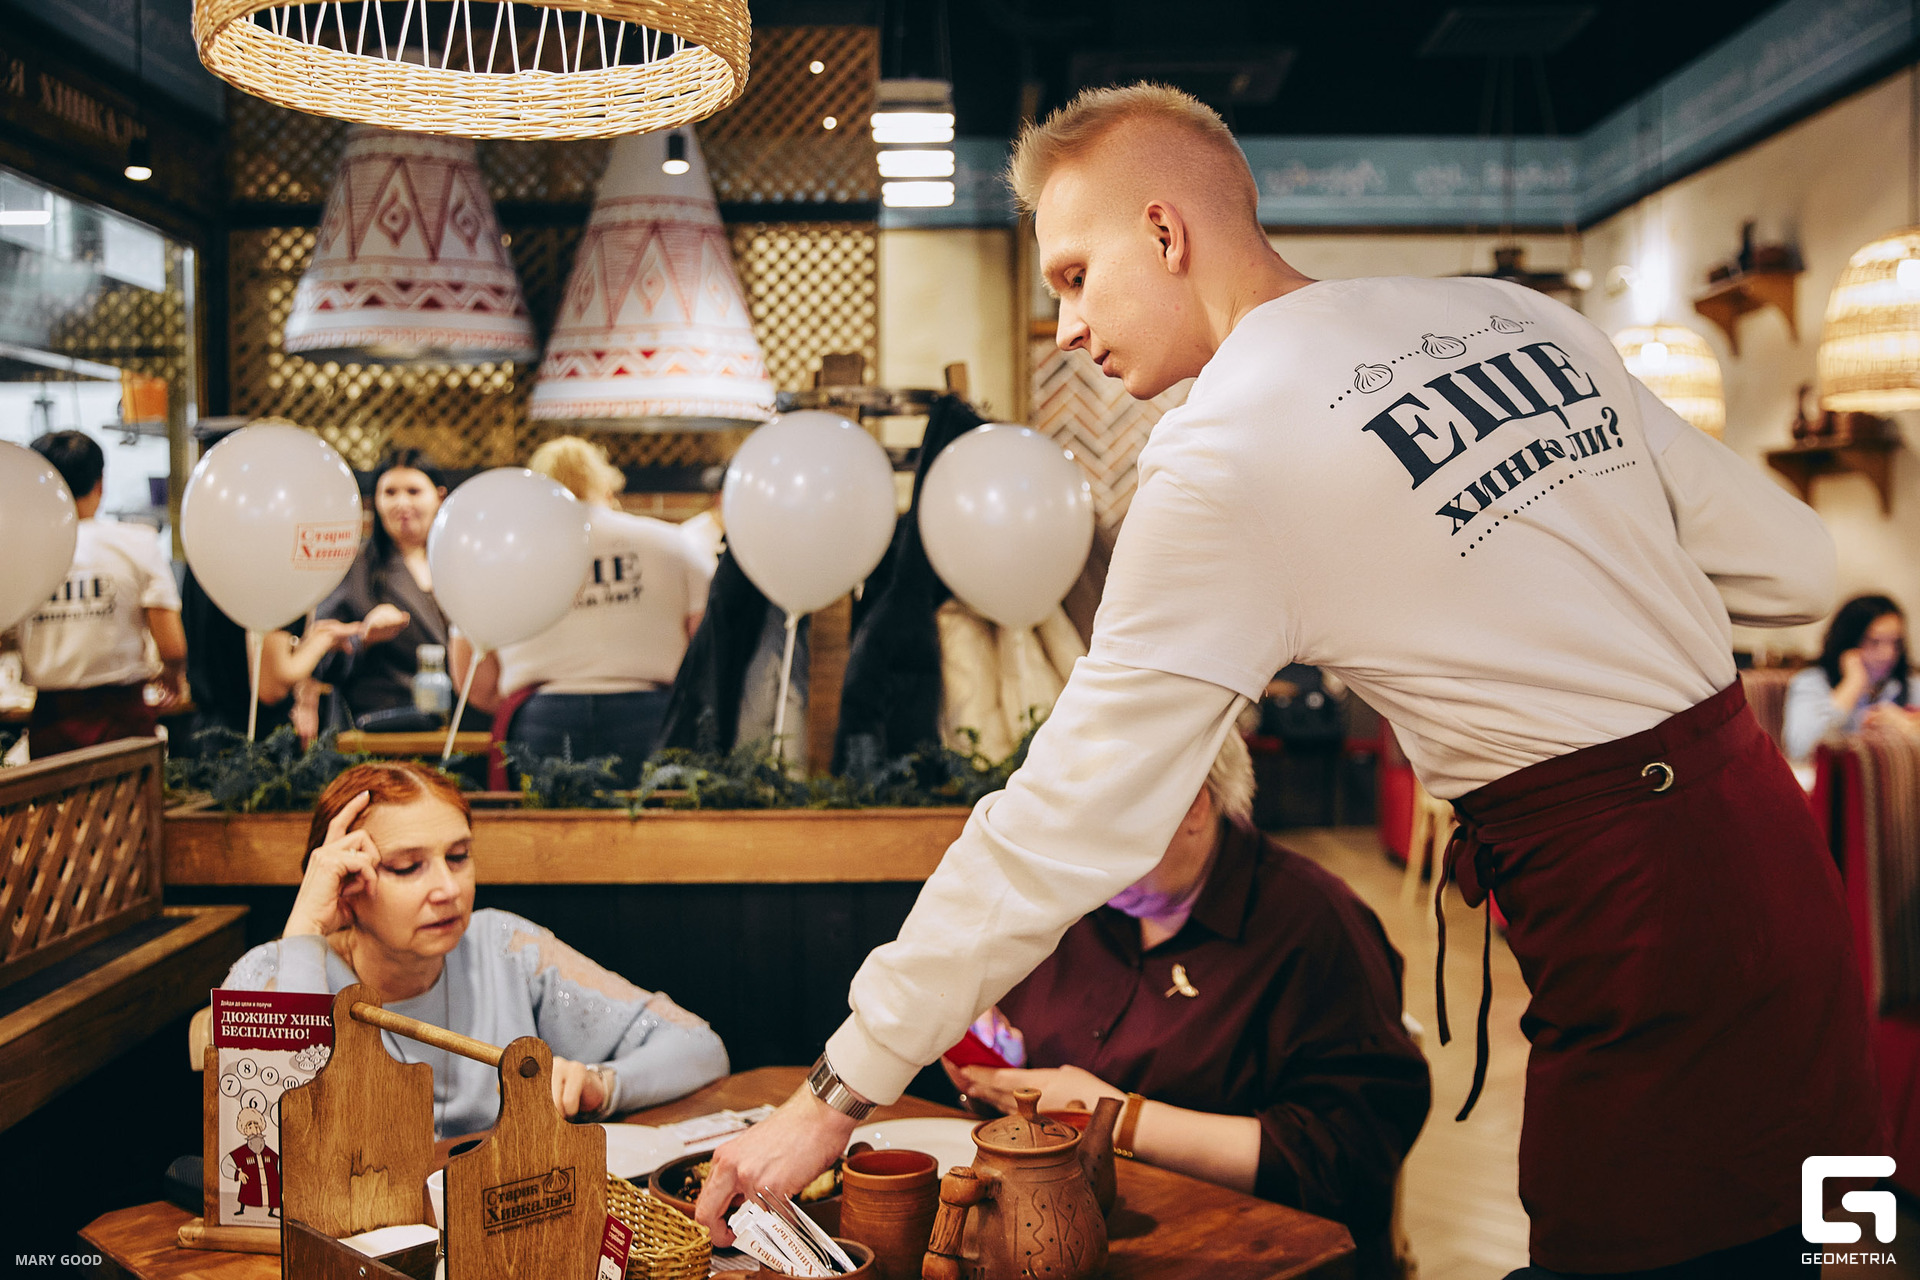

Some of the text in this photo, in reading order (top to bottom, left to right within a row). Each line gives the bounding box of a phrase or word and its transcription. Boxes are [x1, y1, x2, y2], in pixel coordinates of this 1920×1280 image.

[1361, 341, 1601, 490] ЕЩЕ
[221, 1011, 332, 1027] ДЮЖИНУ ХИНК
[222, 1026, 310, 1039] БЕСПЛАТНО!
[243, 1064, 251, 1074] 8
[267, 1071, 274, 1080] 9
[227, 1080, 234, 1091] 7
[286, 1080, 297, 1089] 10
[248, 1096, 258, 1109] 6
[487, 1184, 539, 1206] Старик
[487, 1192, 572, 1224] Хинкалыч
